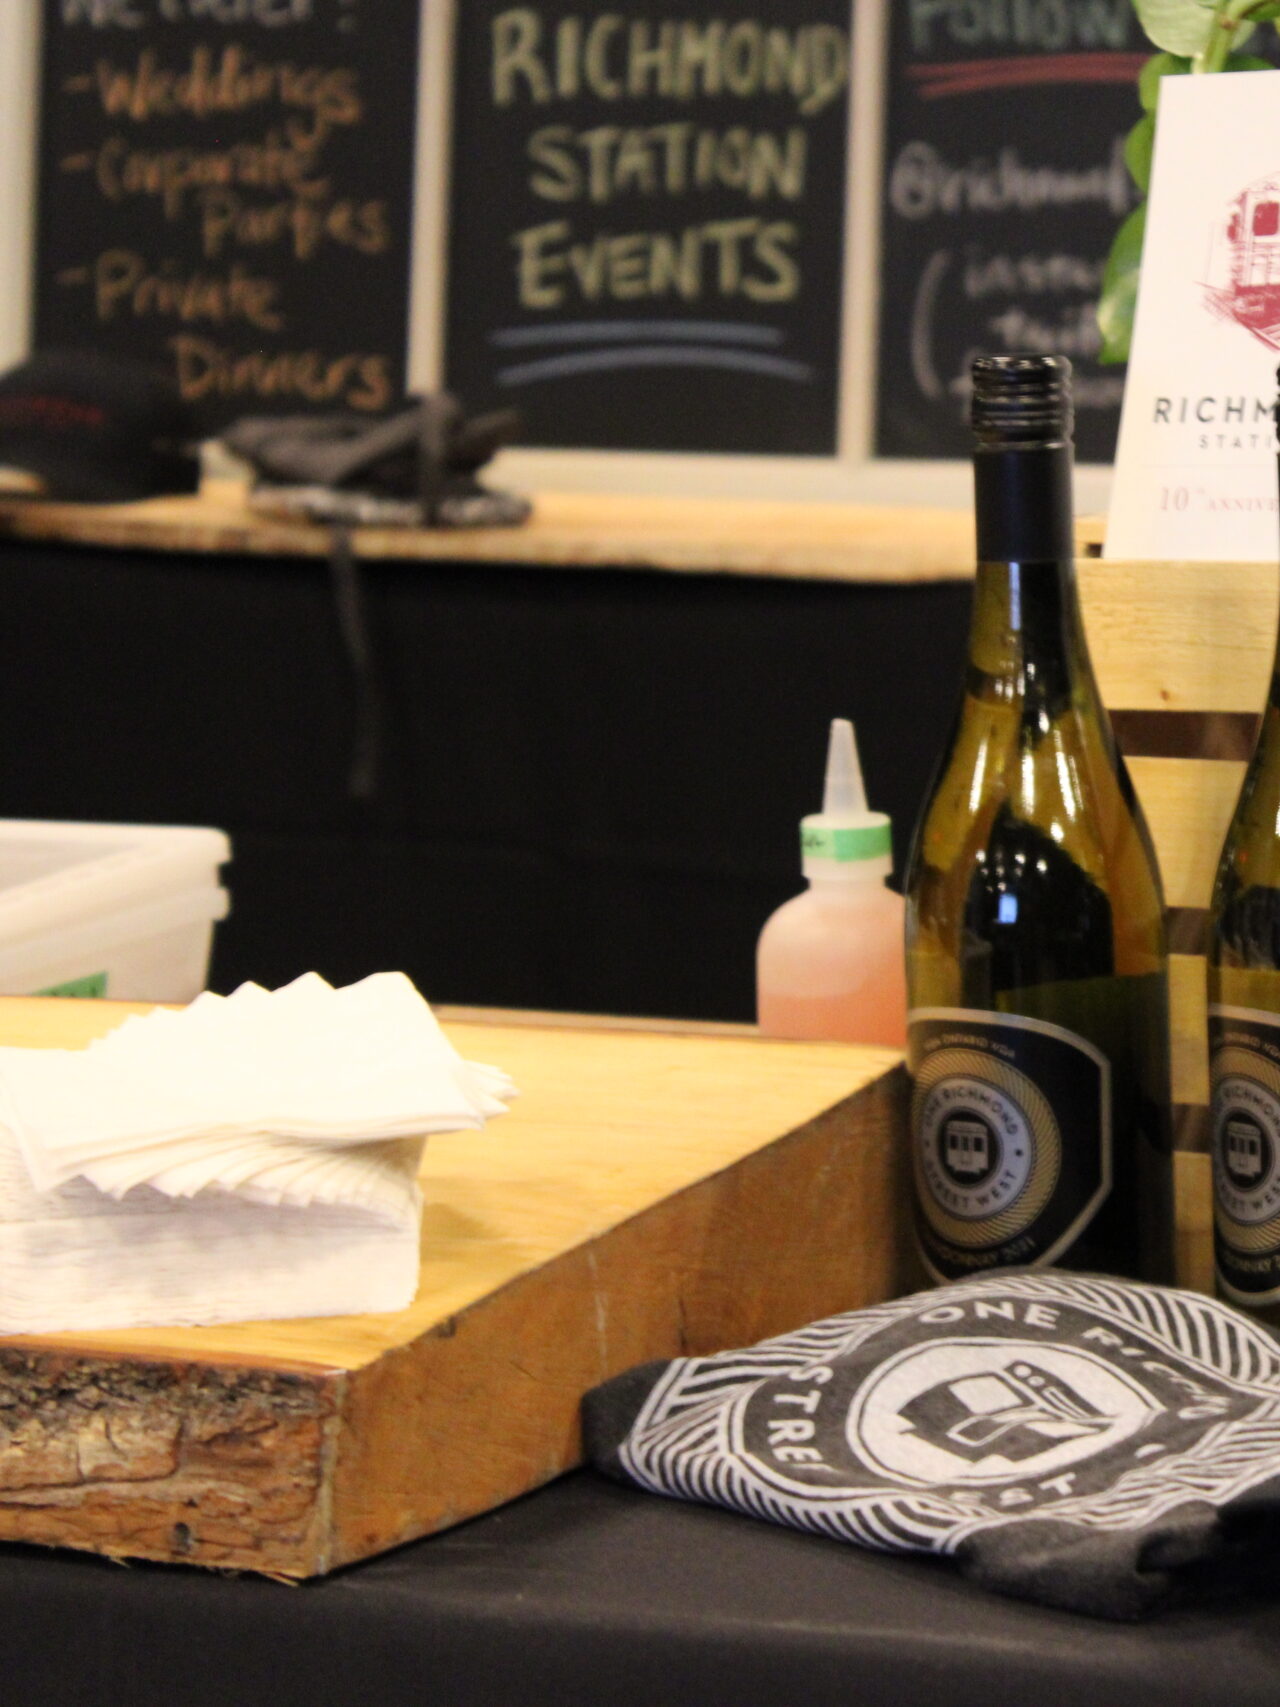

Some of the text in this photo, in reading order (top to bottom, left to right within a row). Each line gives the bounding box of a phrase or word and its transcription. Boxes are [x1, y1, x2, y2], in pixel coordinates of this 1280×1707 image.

[491, 7, 850, 116] RICHMOND
[526, 121, 808, 202] STATION
[511, 217, 800, 310] EVENTS
[1153, 396, 1278, 424] RICHM
[1199, 433, 1276, 450] STATI
[942, 1084, 1019, 1136] RICHMOND
[976, 1170, 1019, 1208] WEST
[918, 1300, 1062, 1330] ONE
